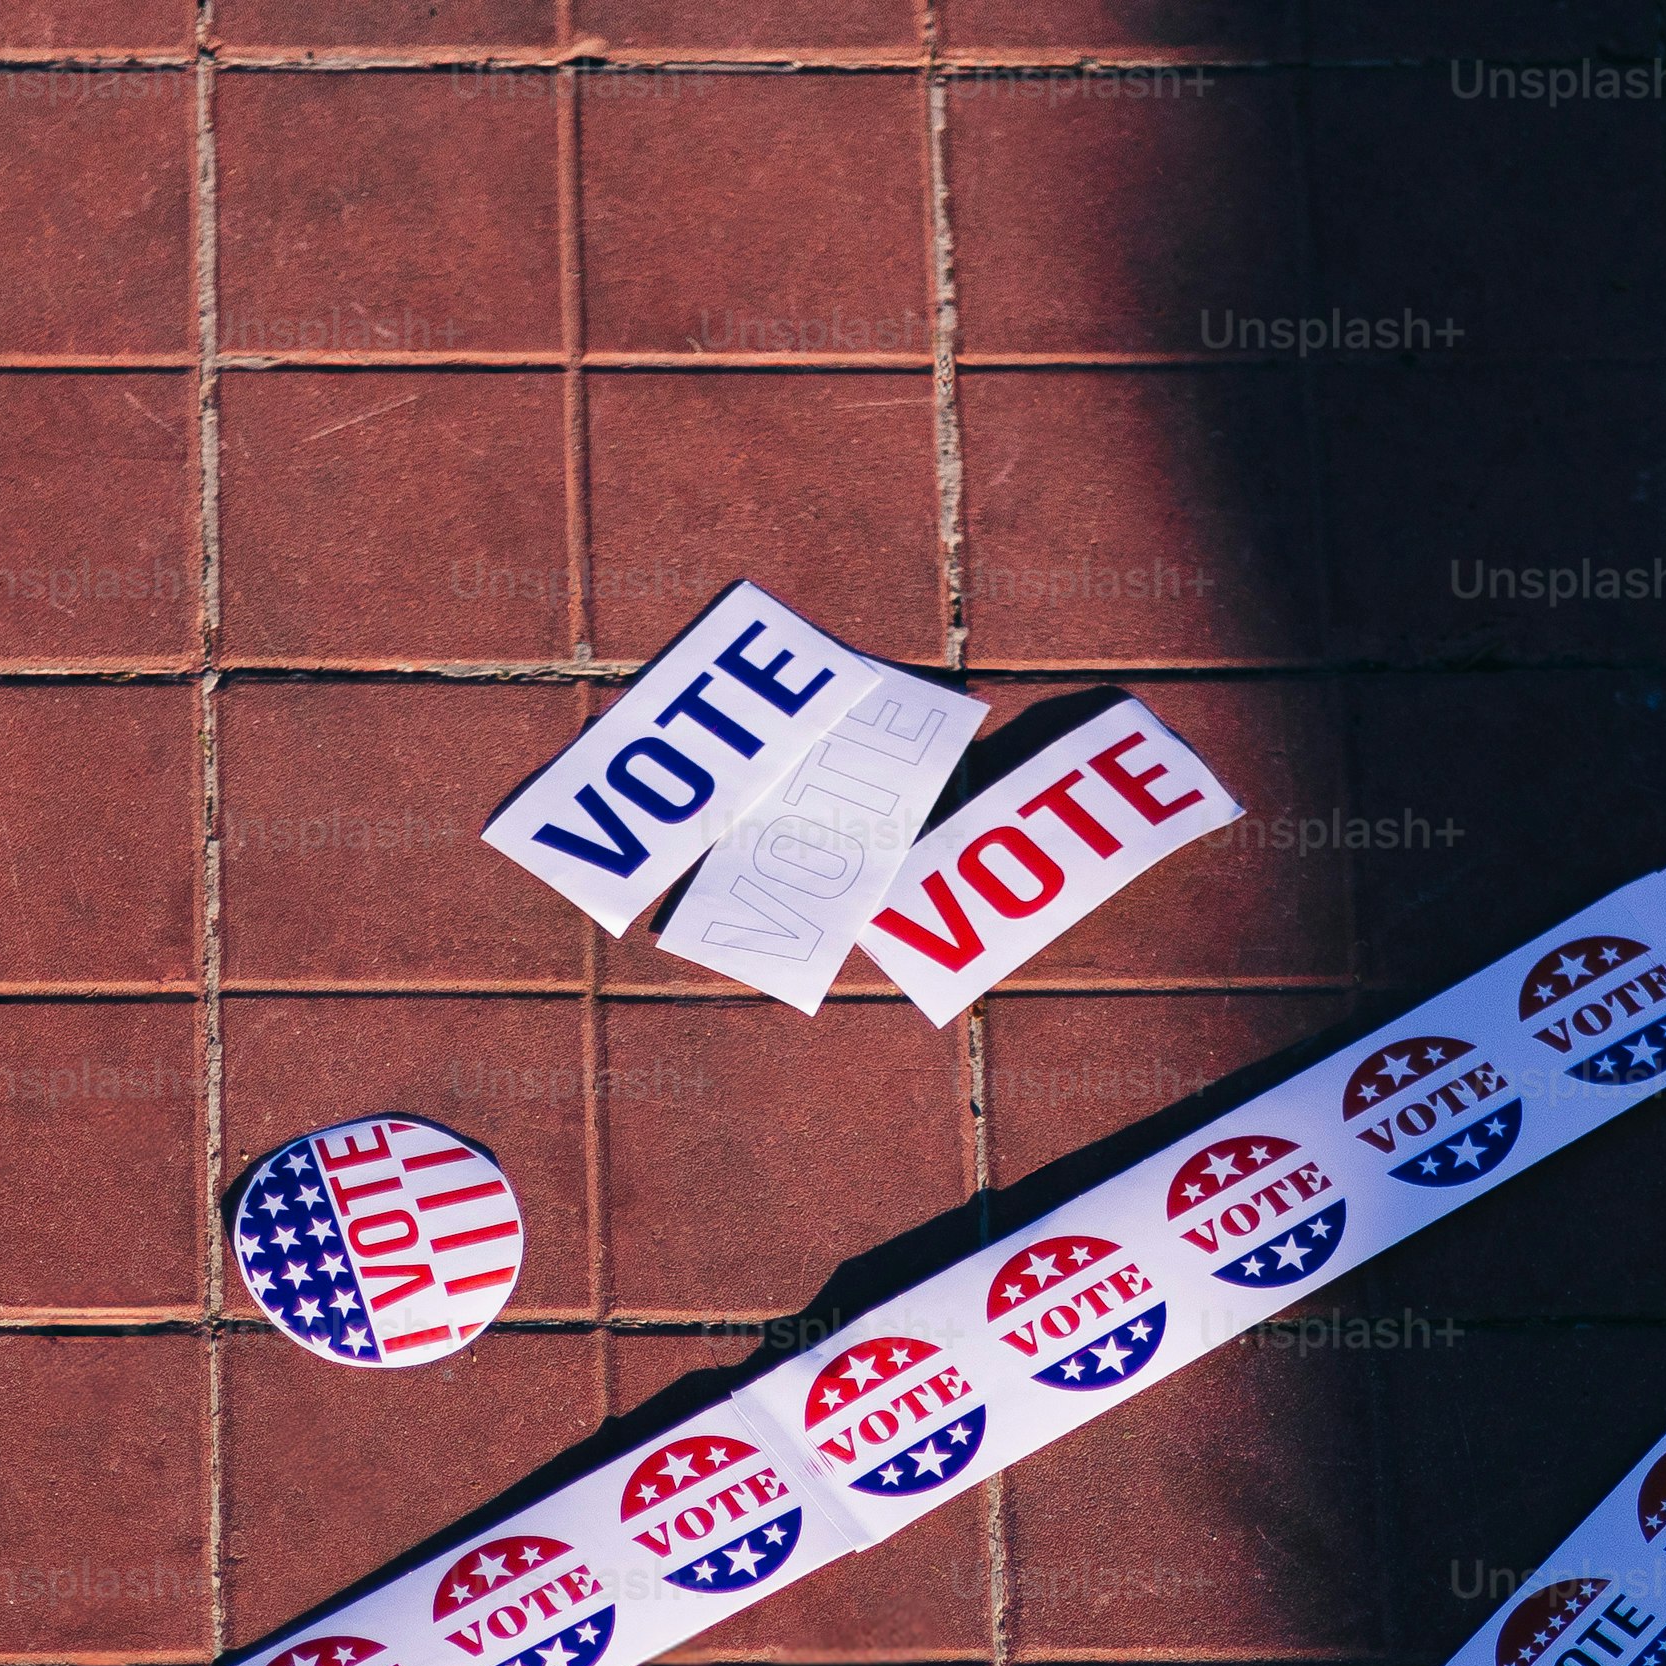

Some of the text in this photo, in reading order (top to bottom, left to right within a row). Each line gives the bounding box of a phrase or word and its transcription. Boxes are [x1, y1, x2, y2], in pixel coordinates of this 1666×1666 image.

[533, 619, 836, 878] VOTE
[701, 699, 947, 962] VOTE
[870, 731, 1206, 973] VOTE
[1356, 1061, 1509, 1155] VOTE
[315, 1124, 453, 1355] I VOTE
[1179, 1161, 1332, 1255] VOTE
[1000, 1263, 1153, 1357] VOTE
[818, 1366, 972, 1465] VOTE
[633, 1467, 788, 1558] VOTE
[445, 1564, 604, 1657] VOTE
